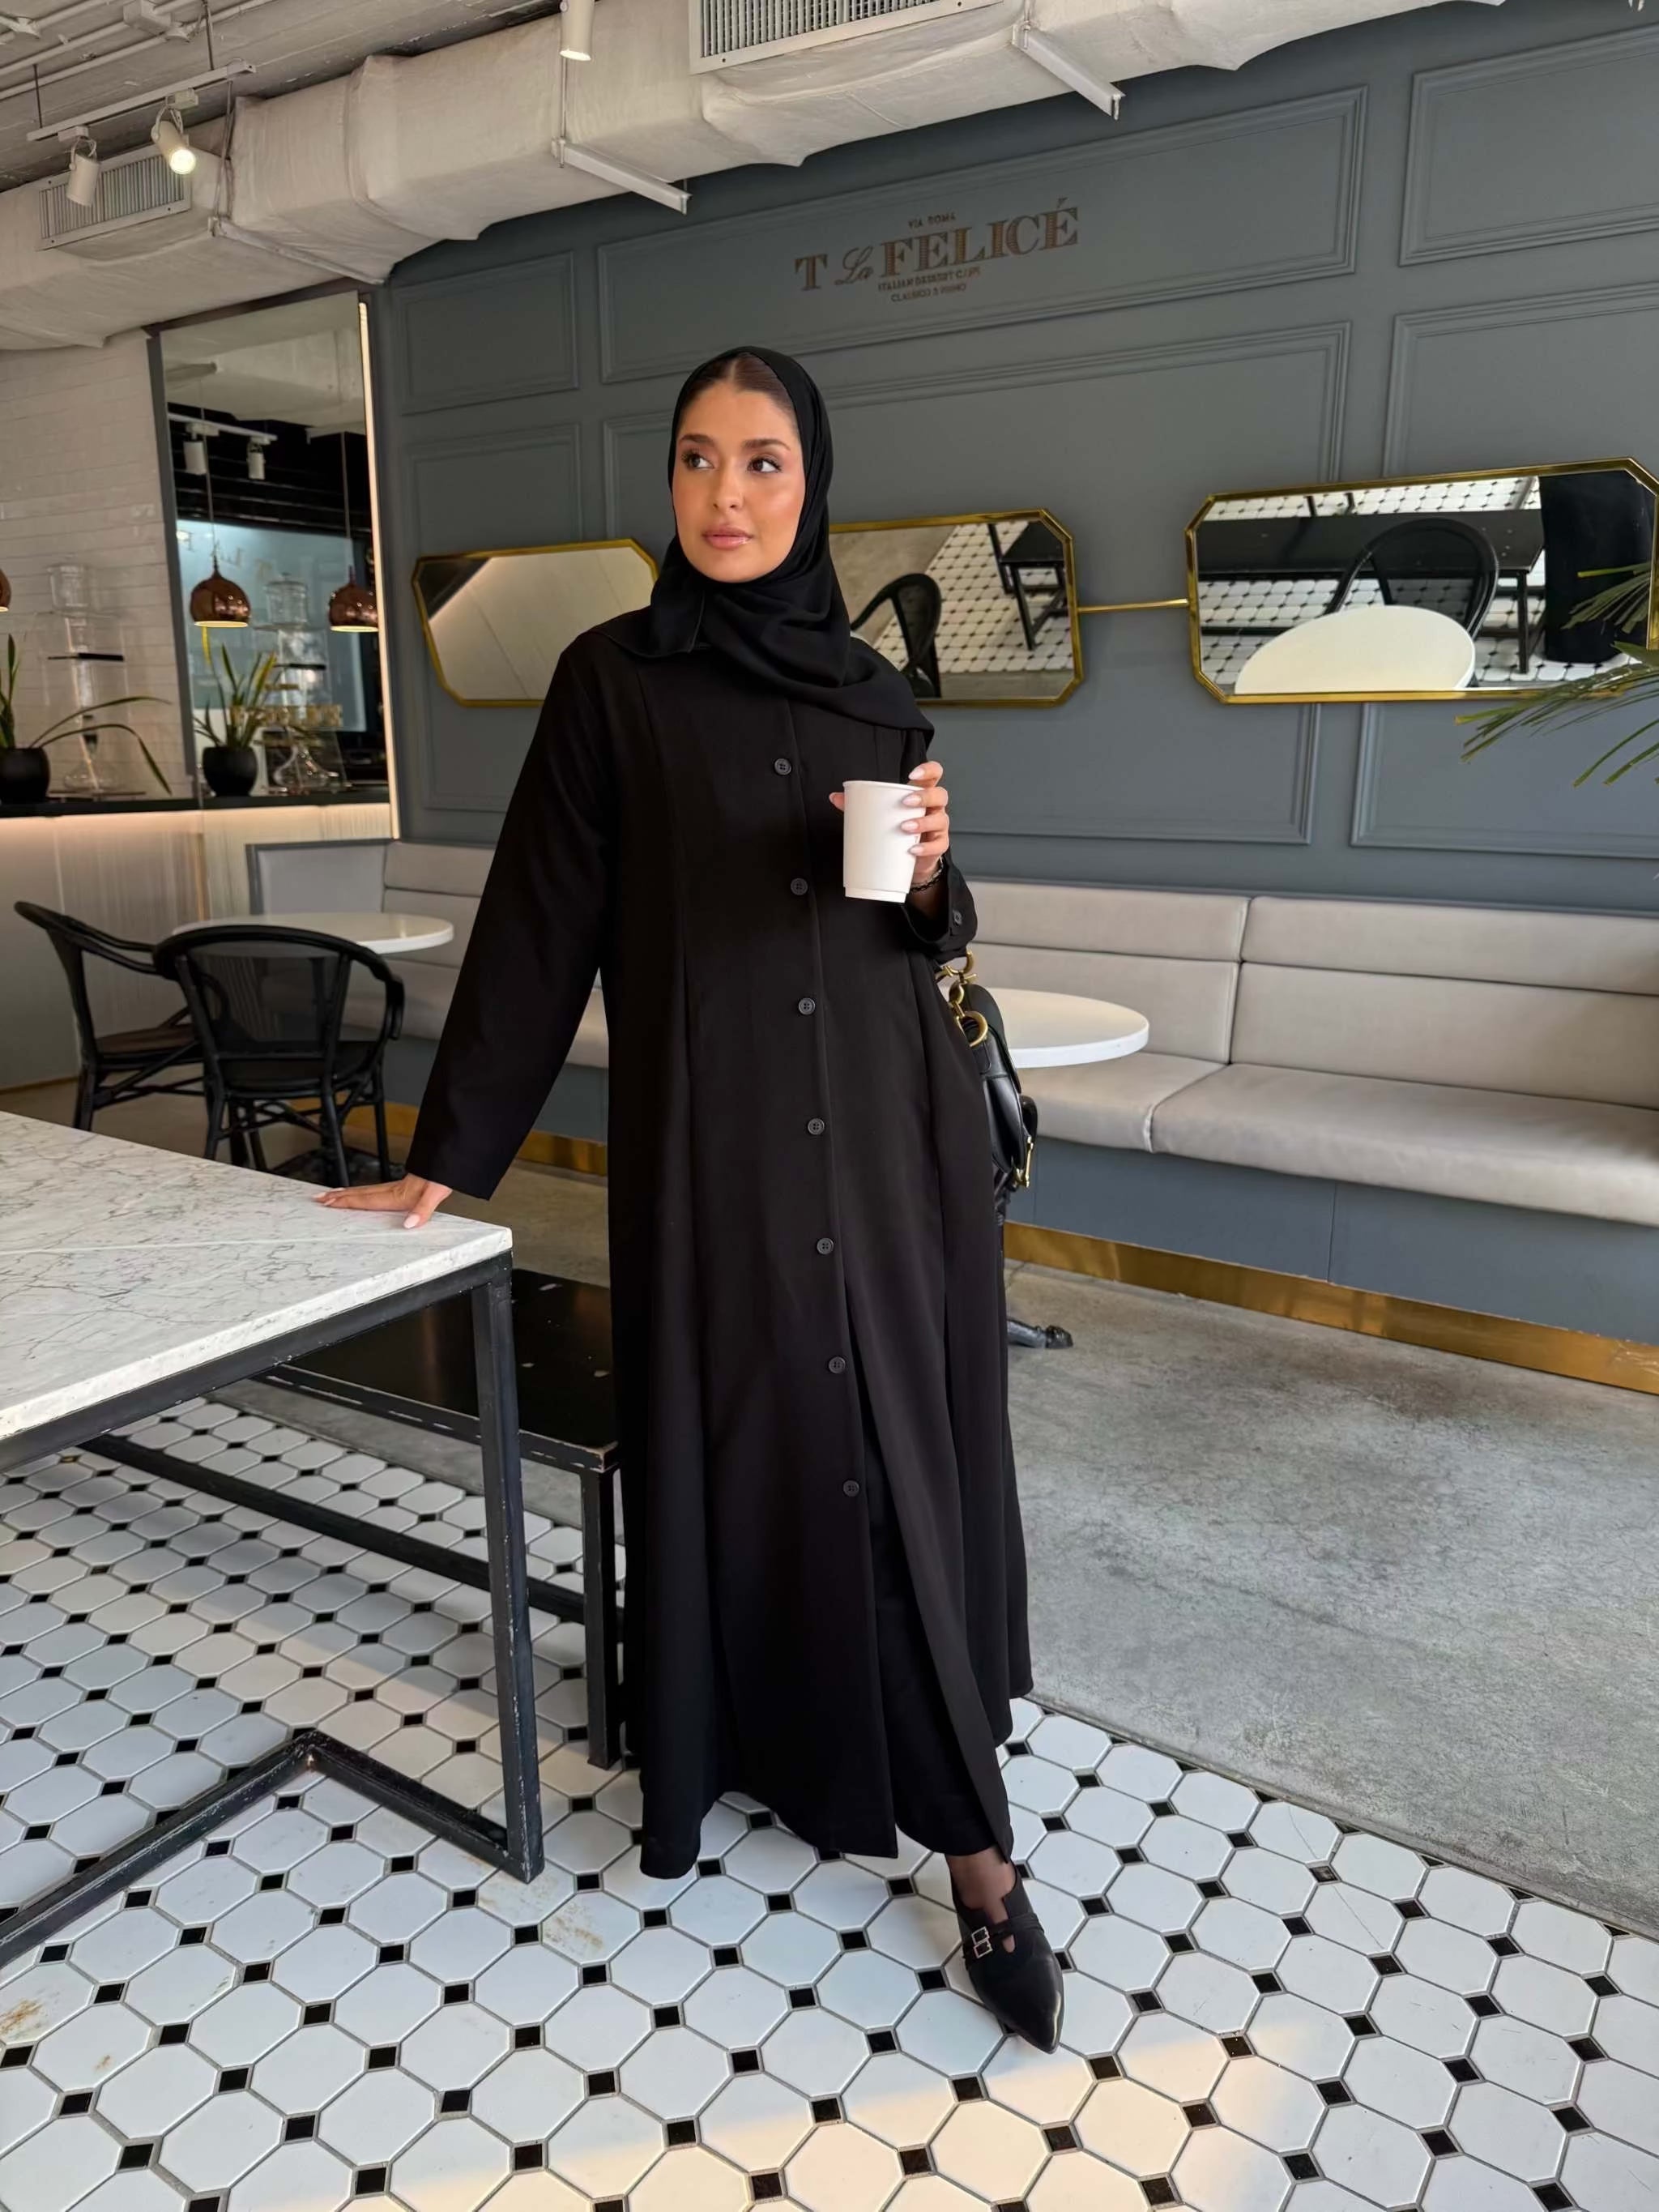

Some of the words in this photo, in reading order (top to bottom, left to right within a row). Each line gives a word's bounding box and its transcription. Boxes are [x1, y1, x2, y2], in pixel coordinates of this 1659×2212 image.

[794, 253, 829, 292] T
[834, 246, 874, 286] La
[881, 195, 1080, 278] FELICÉ
